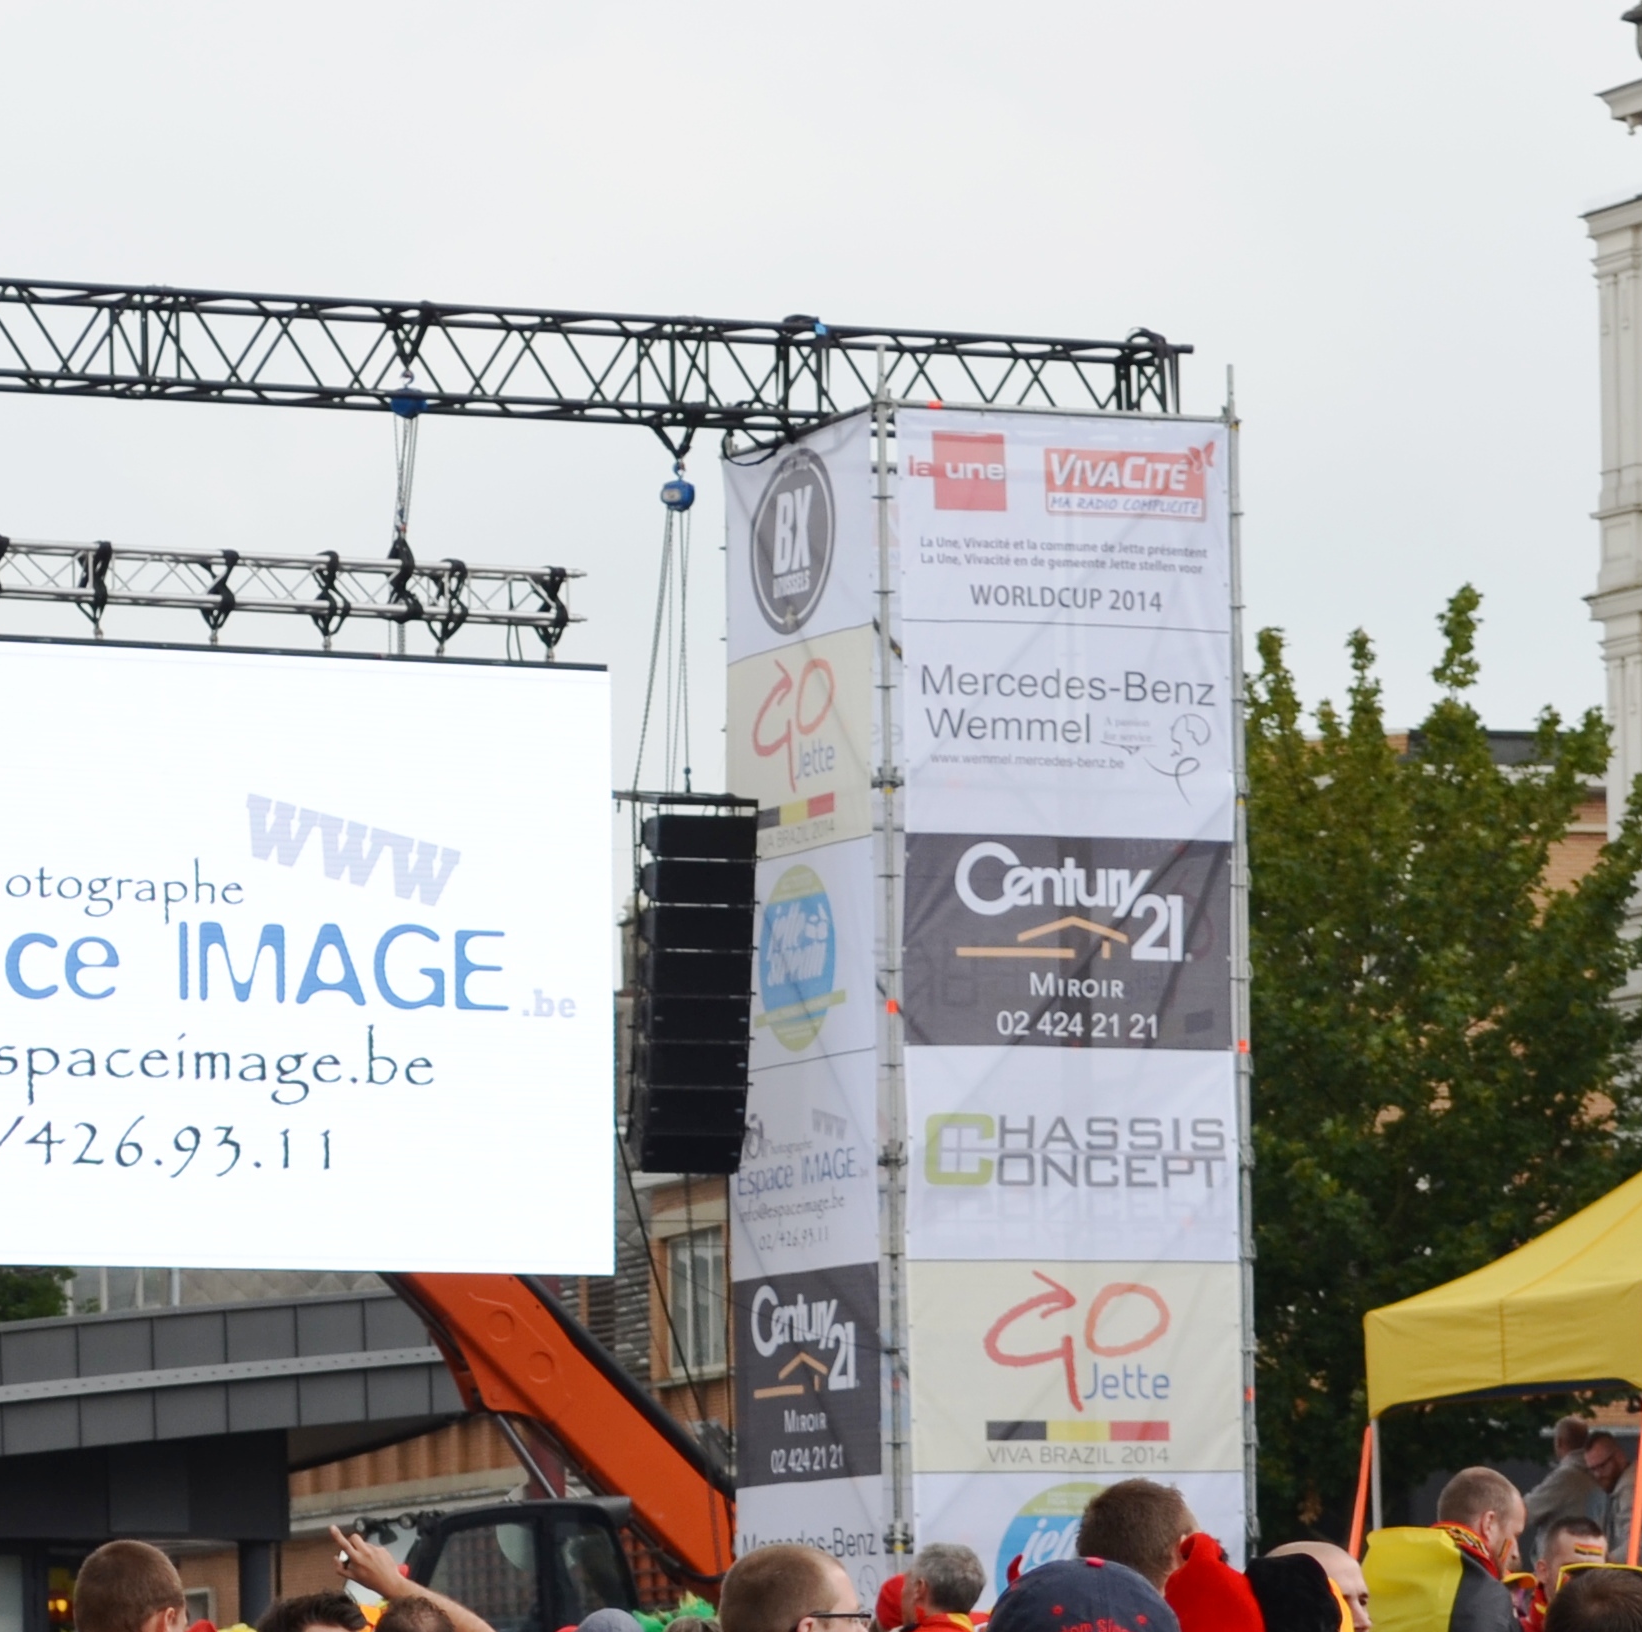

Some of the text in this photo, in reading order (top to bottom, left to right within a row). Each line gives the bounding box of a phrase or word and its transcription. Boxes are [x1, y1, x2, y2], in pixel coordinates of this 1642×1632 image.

[908, 456, 1005, 480] la une
[1051, 496, 1071, 509] MA
[1077, 497, 1118, 510] RADIO
[773, 484, 812, 575] BX
[921, 536, 1207, 559] La Une, Vivacité et la commune de Jette présentent
[921, 553, 1203, 574] La Une, Vivacité en de gemeente Jette stellen voor
[970, 584, 1163, 612] WORLDCUP 2014
[921, 664, 1216, 707] Mercedes-Benz
[925, 708, 1091, 744] Wemmel
[1119, 732, 1152, 743] service
[796, 739, 835, 780] Jette
[930, 753, 1125, 770] www.wemmel.mercedes-benz.be
[247, 793, 462, 907] www
[955, 841, 1184, 962] Century 21
[178, 921, 510, 1012] IMAGE
[522, 989, 577, 1018] .be
[996, 1010, 1157, 1038] 02 424 21 21
[737, 1147, 856, 1199] Espace IMAGE
[751, 1285, 856, 1391] Century 21
[1083, 1362, 1170, 1400] Jette
[771, 1444, 844, 1474] 02 424 21 21
[987, 1446, 1169, 1464] VIVA BRAZIL 2014
